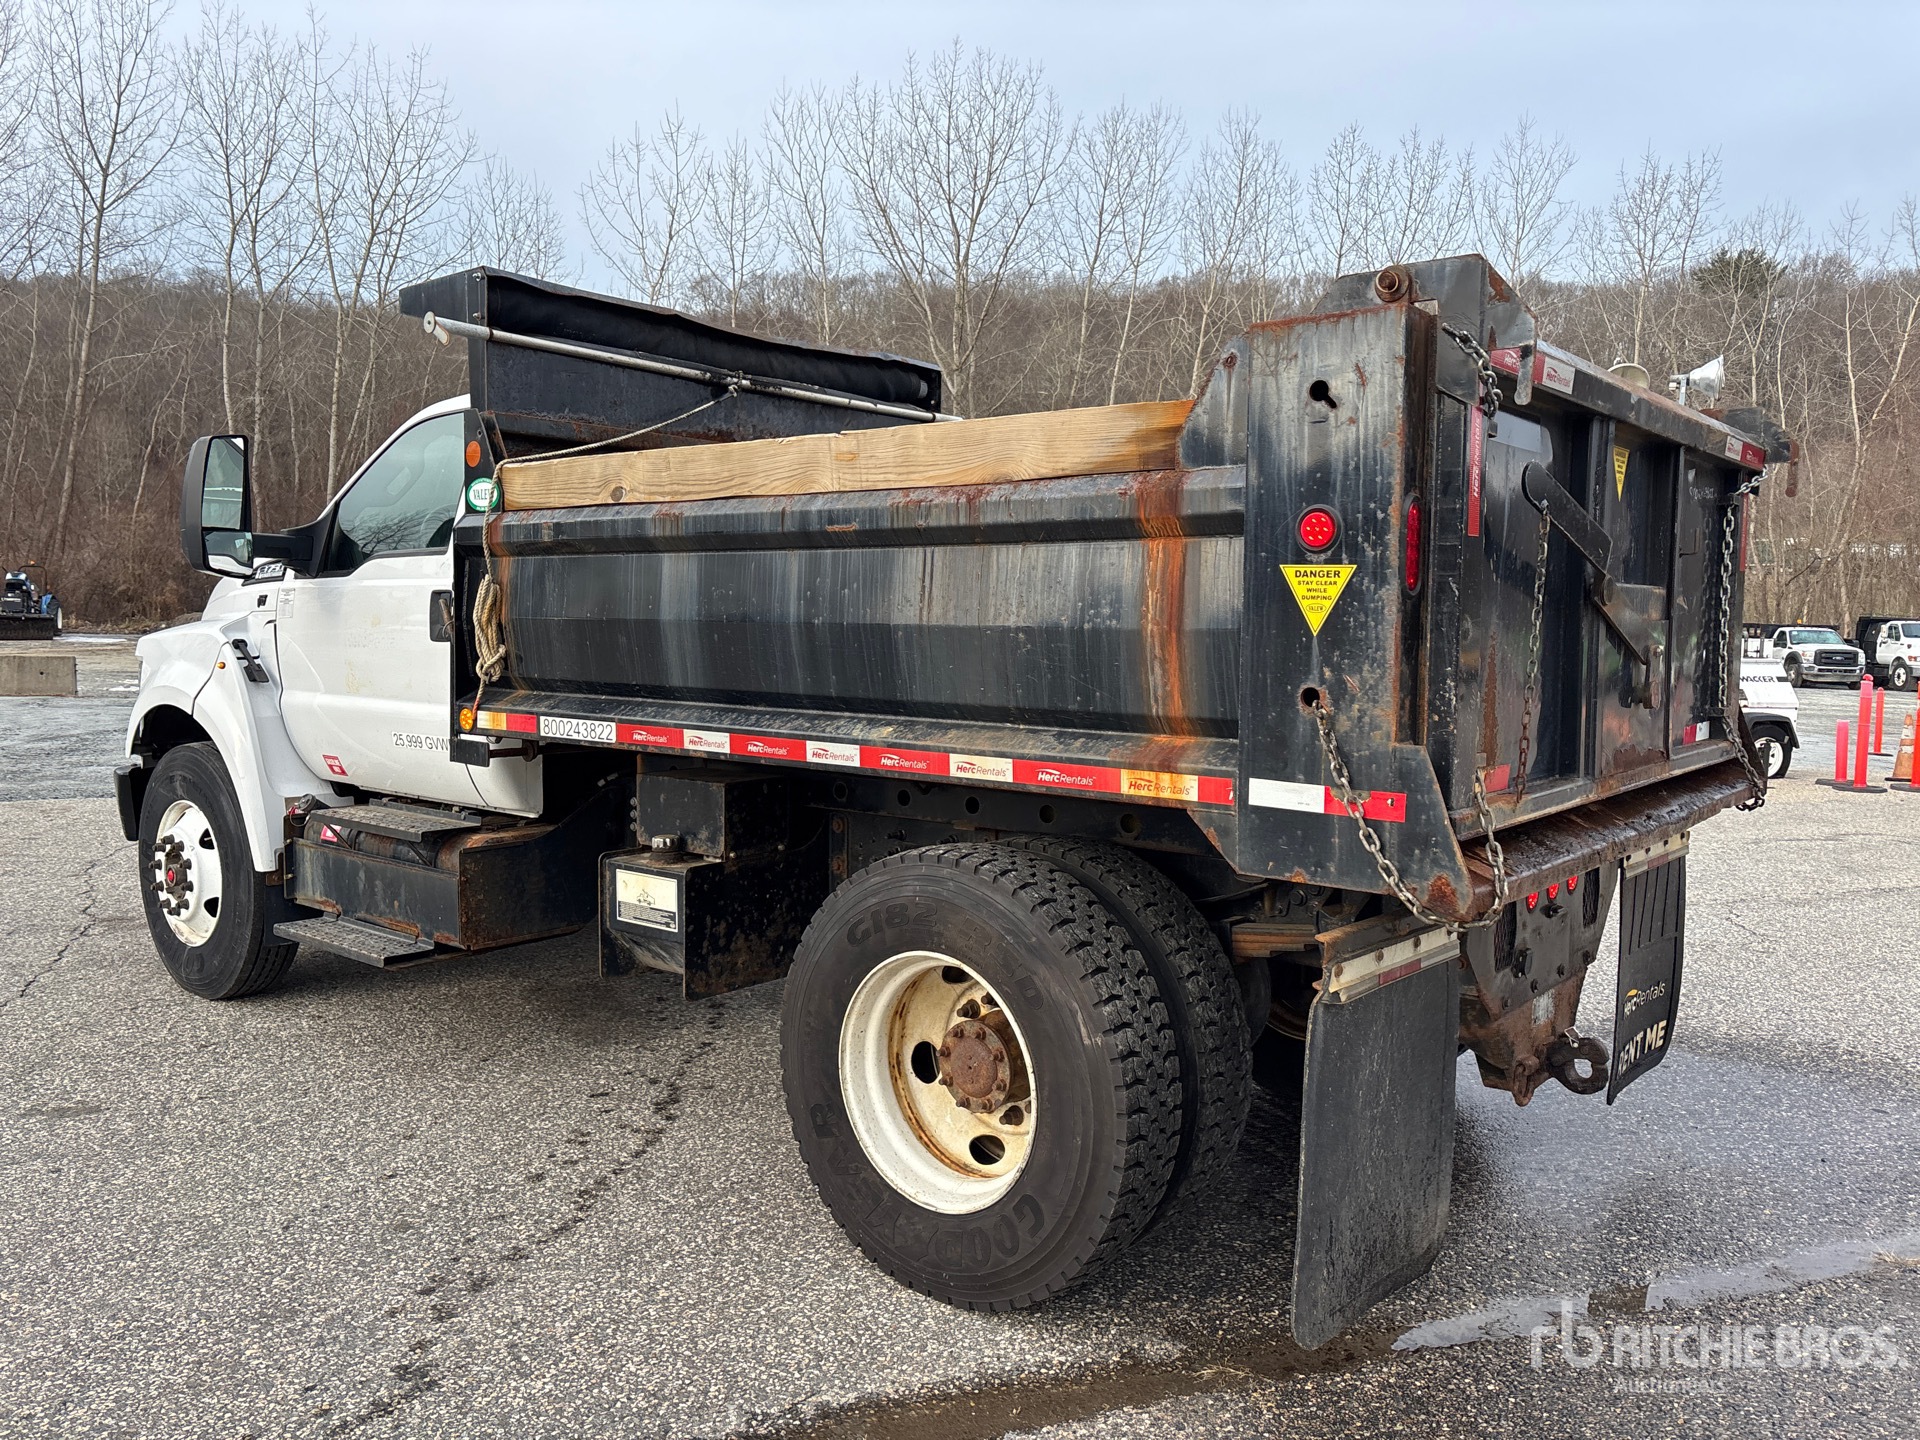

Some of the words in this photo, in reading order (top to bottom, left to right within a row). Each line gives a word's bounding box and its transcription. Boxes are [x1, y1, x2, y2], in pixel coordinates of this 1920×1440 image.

[1294, 570, 1341, 578] DANGER
[393, 733, 423, 748] 25,999
[543, 718, 613, 741] 800243822
[846, 902, 938, 948] G182
[1618, 1031, 1644, 1076] RENT
[1645, 1020, 1667, 1054] ME
